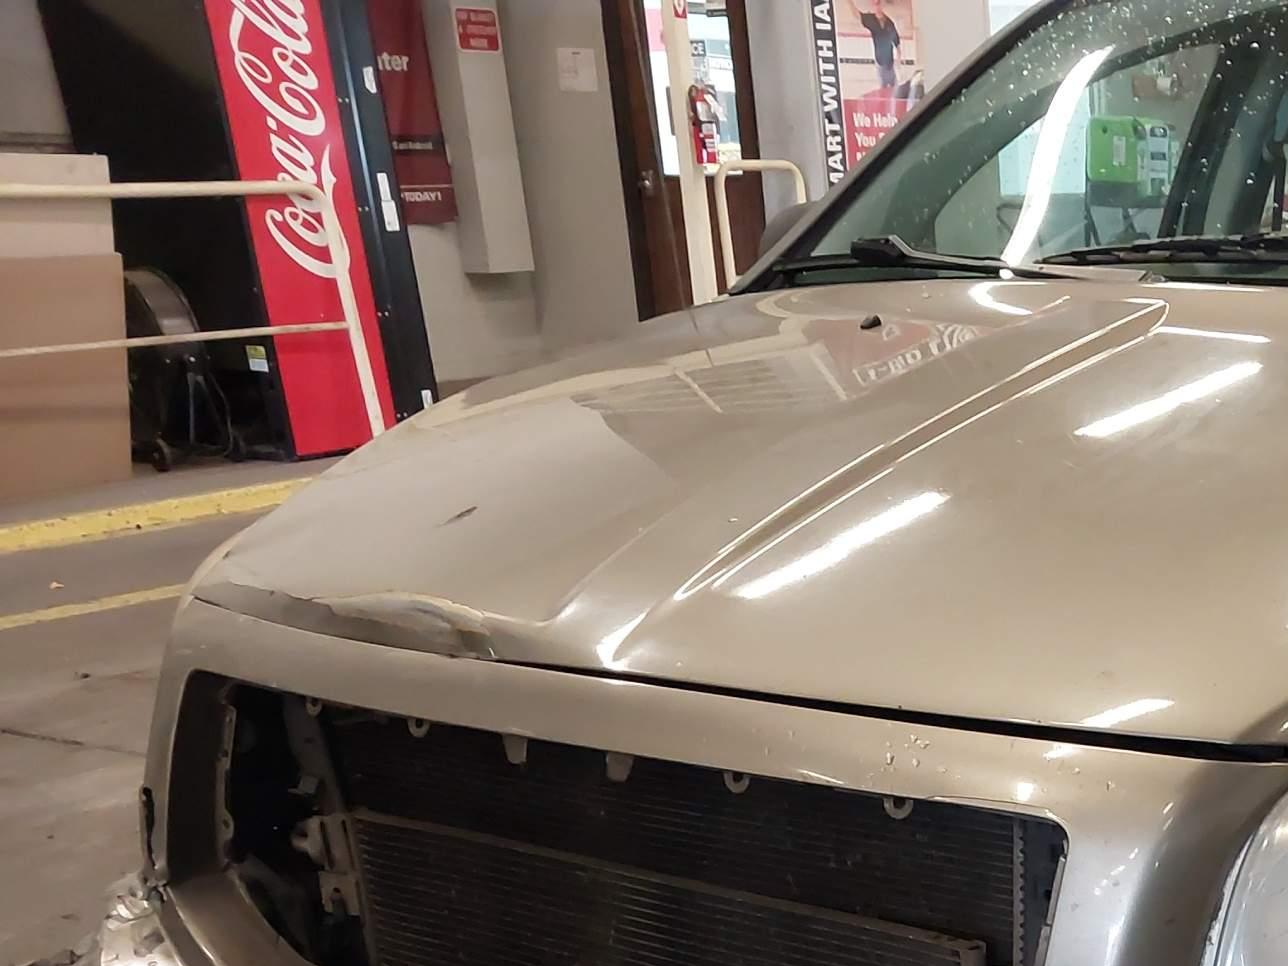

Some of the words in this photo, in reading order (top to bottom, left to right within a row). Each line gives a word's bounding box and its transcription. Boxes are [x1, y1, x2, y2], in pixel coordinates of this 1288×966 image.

[813, 0, 833, 30] IA
[817, 39, 839, 114] WITH
[852, 112, 871, 127] We
[854, 132, 876, 148] You
